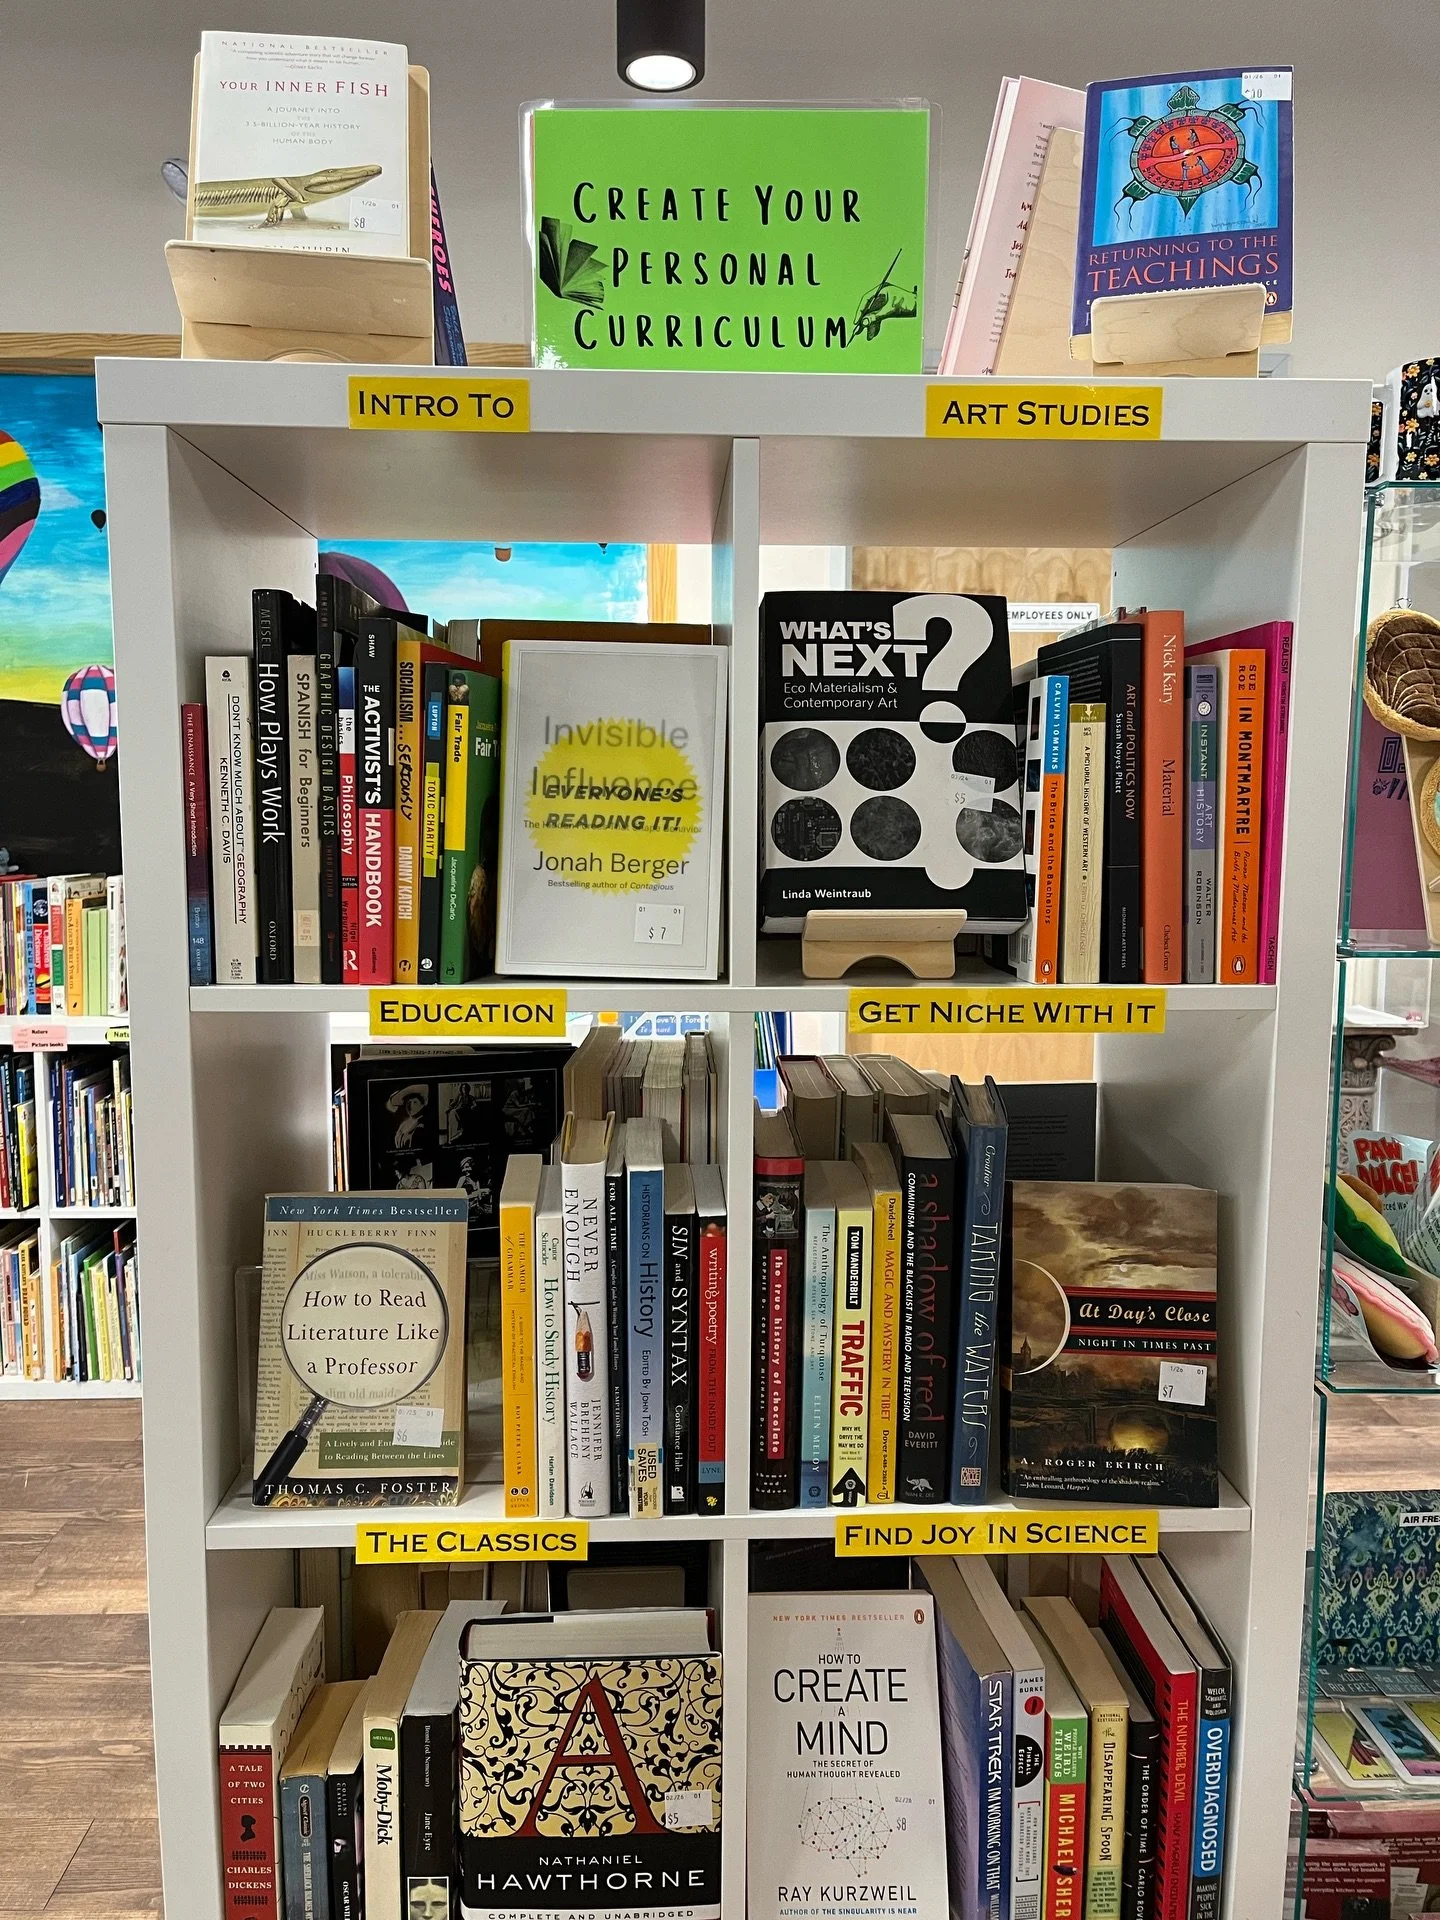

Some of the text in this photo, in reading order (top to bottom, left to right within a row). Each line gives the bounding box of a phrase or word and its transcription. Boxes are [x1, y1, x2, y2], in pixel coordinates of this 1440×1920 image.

[220, 80, 388, 97] YOUR INNER FISH
[574, 182, 861, 226] CREATE YOUR
[354, 217, 366, 229] $8
[1089, 234, 1278, 266] RETURNING TO THE
[612, 247, 821, 288] PERSONAL
[1088, 252, 1280, 292] TEACHINGS
[574, 309, 848, 350] CURRICULUM
[359, 391, 514, 418] INTRO TO
[942, 400, 1150, 426] ART STUDIES
[1065, 610, 1093, 620] ONLY
[780, 621, 893, 640] WHAT'S
[1159, 634, 1176, 706] Nick Kary
[363, 685, 380, 693] THE
[784, 682, 898, 694] Eco Materialism &
[784, 696, 898, 710] Contemporary Art
[544, 716, 689, 750] Invisible
[256, 663, 286, 844] How Plays Work
[296, 673, 313, 848] SPANISH for Beginners
[1200, 724, 1208, 778] INSTANT
[954, 792, 966, 804] $5
[1162, 759, 1176, 816] Material
[341, 775, 354, 854] Philosophy
[366, 814, 382, 928] HANDBOOK
[533, 850, 690, 878] Jonah Berger
[782, 888, 872, 900] Linda Weintraub
[380, 1001, 554, 1022] EDUCATION
[858, 1001, 1156, 1024] GET NICHE WITH IT
[1353, 1136, 1403, 1162] PAW
[279, 1206, 460, 1216] New York Times Bestseller
[307, 1229, 437, 1238] HUCKLEBERRY FINN
[564, 1188, 580, 1282] ENOUGH
[583, 1198, 599, 1272] NEVER
[850, 1230, 860, 1306] TOM VANDERBILT
[303, 1290, 427, 1308] How to Read
[634, 1262, 658, 1338] History
[672, 1226, 688, 1386] SIN and SYNTAX
[704, 1248, 722, 1344] writing poetry
[962, 1222, 998, 1430] TAKING the WATERS
[1080, 1303, 1211, 1324] At Day's Close
[288, 1323, 440, 1340] Literature Like
[542, 1278, 560, 1424] How to Study History
[1078, 1338, 1212, 1351] NIGHT IN TIMES PAST
[308, 1357, 418, 1375] a Professor
[840, 1320, 865, 1418] TRAFFIC
[1162, 1385, 1174, 1398] $7
[396, 1429, 408, 1442] $6
[570, 1401, 578, 1459] WALLACE
[580, 1402, 591, 1460] BREHENY
[592, 1400, 602, 1461] JENNIFER
[882, 1430, 890, 1452] Dover
[908, 1431, 935, 1439] DAVID
[904, 1440, 938, 1449] EVERITT
[638, 1448, 647, 1482] SAVES
[266, 1482, 450, 1496] THOMAS C. FOSTER
[1404, 1516, 1420, 1524] AIR
[366, 1531, 577, 1552] THE CLASSICS
[845, 1522, 1148, 1546] FIND JOY IN SCIENCE
[818, 1654, 861, 1665] HOW TO
[774, 1668, 908, 1703] CREATE
[798, 1721, 888, 1756] MIND
[988, 1680, 1003, 1784] STAR TREK
[787, 1770, 901, 1778] HUMAN THOUGHT REVEALED
[374, 1763, 394, 1846] Moby-Dick
[1200, 1727, 1223, 1872] OVERDIAGNOSED
[668, 1812, 680, 1825] $5
[896, 1817, 907, 1831] $8
[1058, 1794, 1076, 1866] MICHAEL
[226, 1866, 272, 1874] CHARLES
[539, 1855, 642, 1866] NATHANIEL
[477, 1870, 705, 1891] HAWTHORNE
[1196, 1883, 1218, 1892] MAKING
[778, 1885, 917, 1902] RAY KURZWEIL
